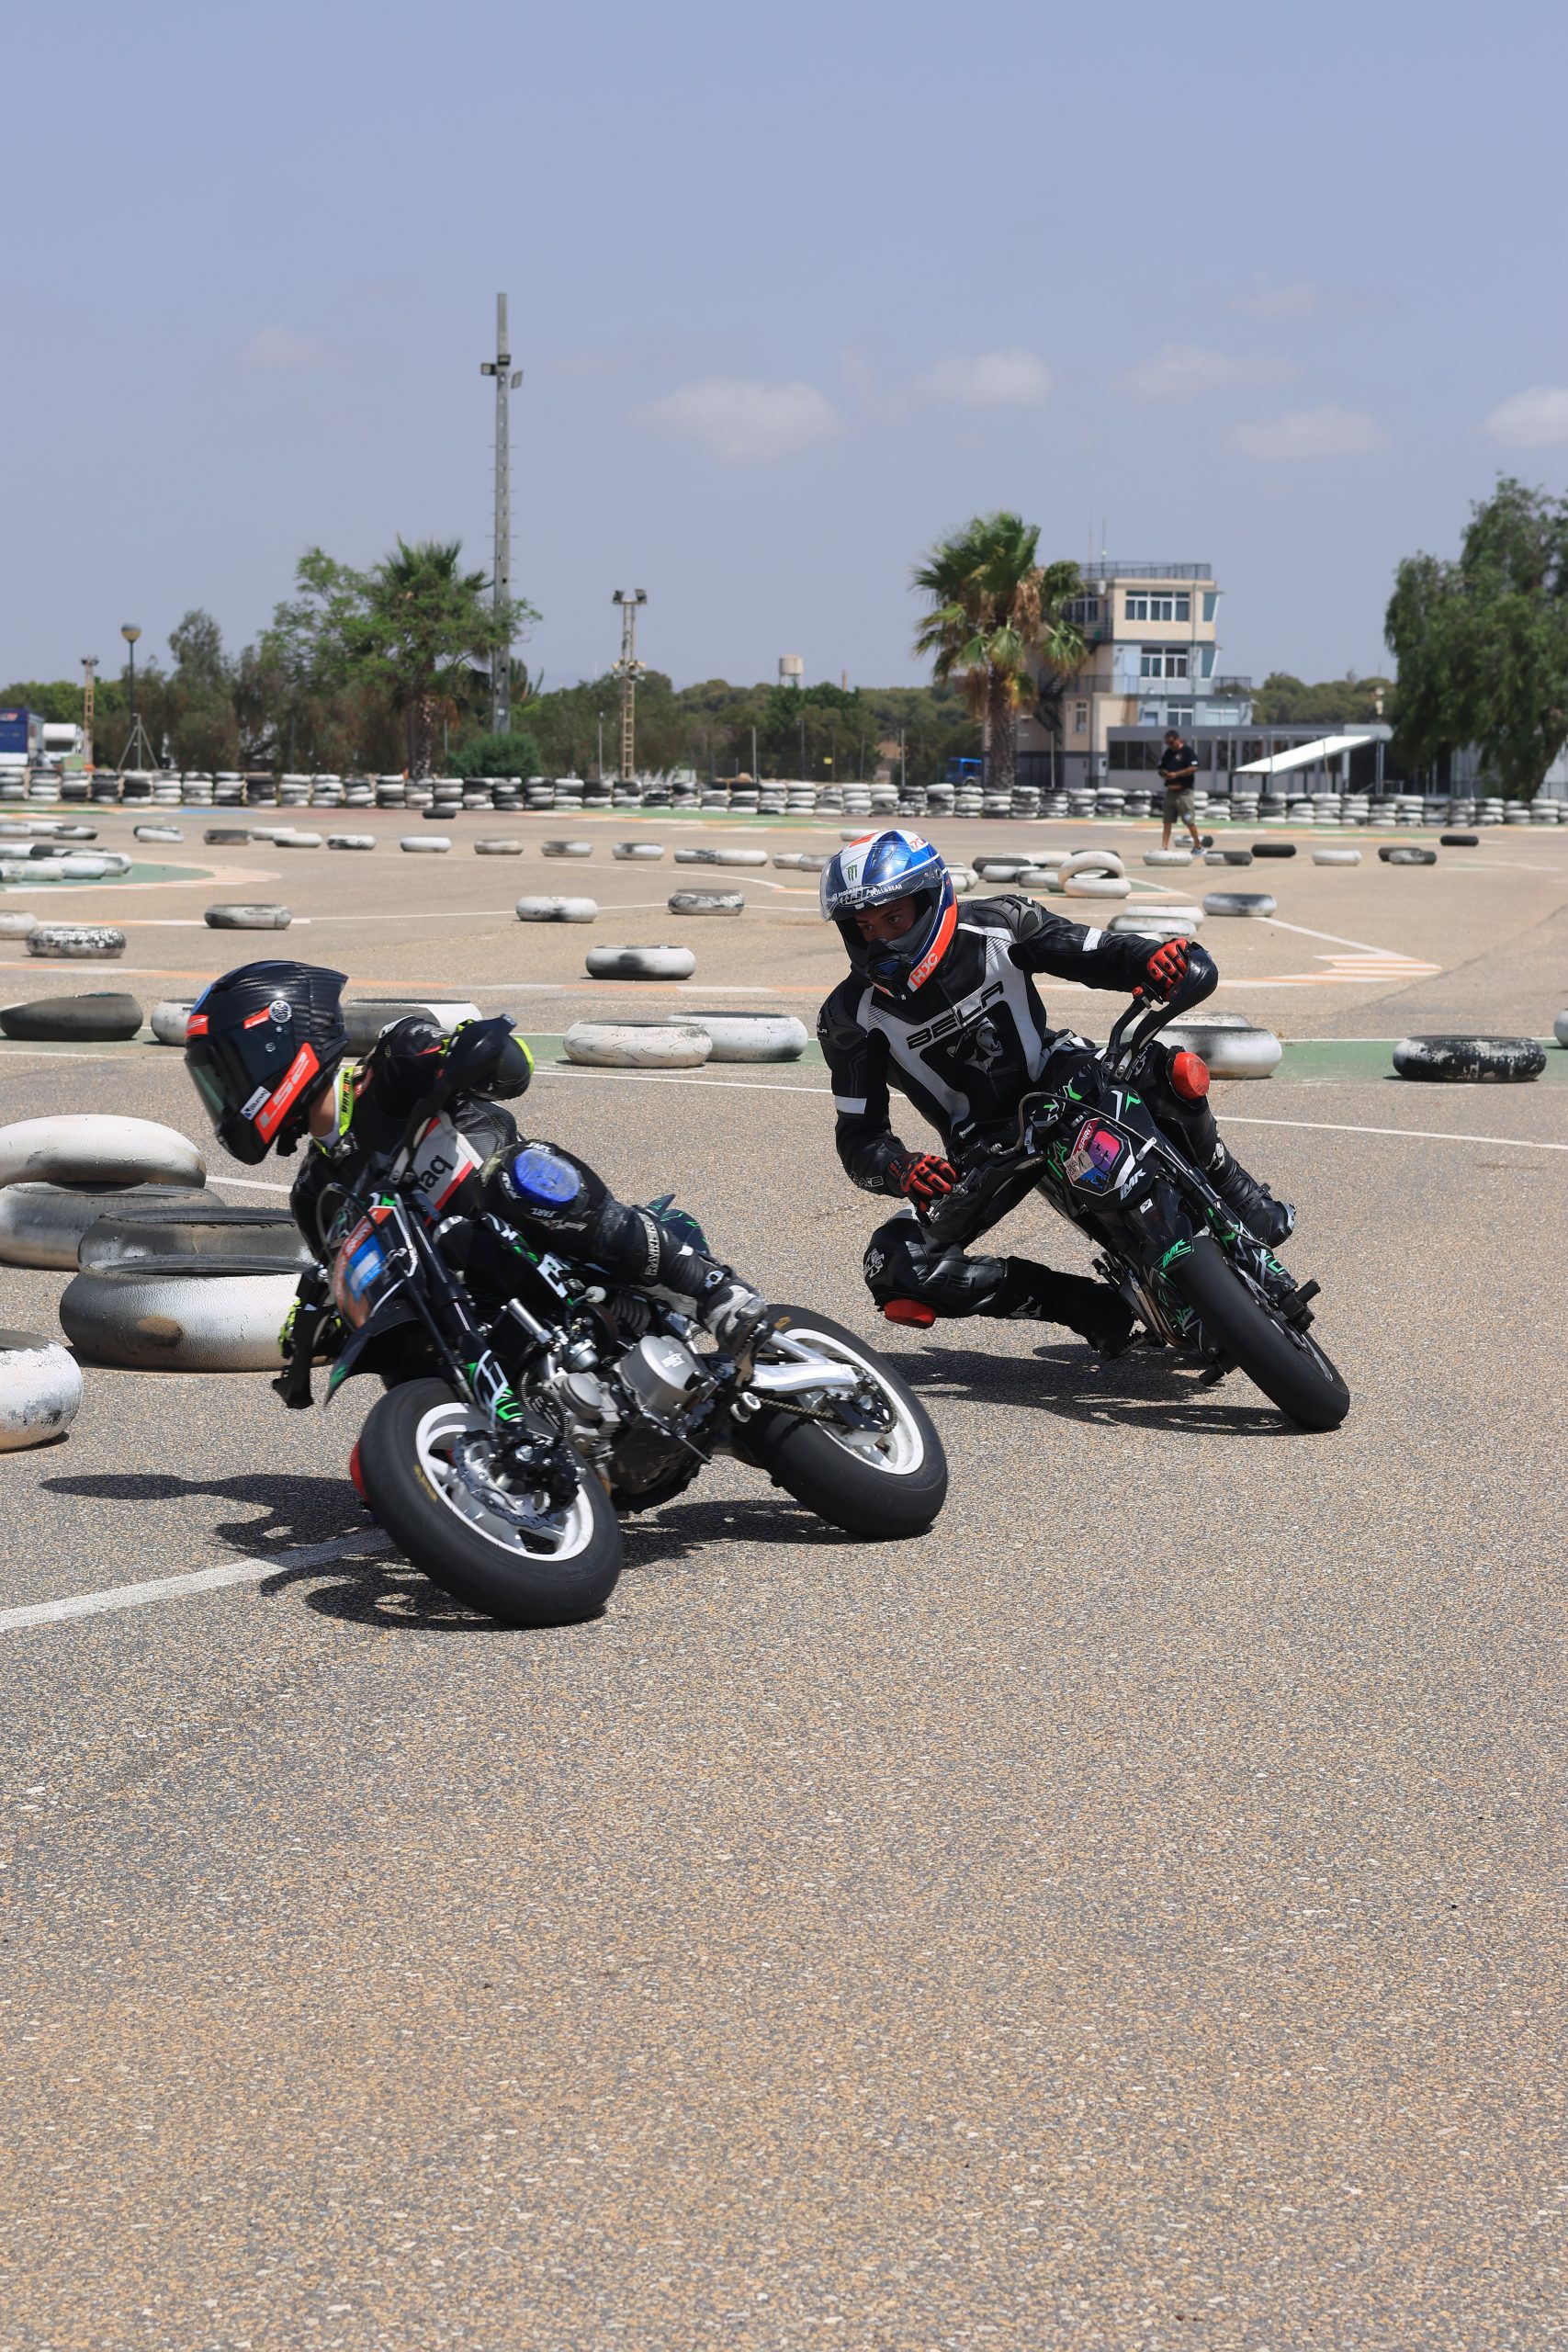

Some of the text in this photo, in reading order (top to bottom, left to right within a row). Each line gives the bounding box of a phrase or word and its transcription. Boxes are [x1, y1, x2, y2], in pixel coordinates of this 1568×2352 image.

[912, 953, 938, 983] HJC
[259, 1051, 310, 1129] LS2
[1077, 1122, 1093, 1150] SPIRIT
